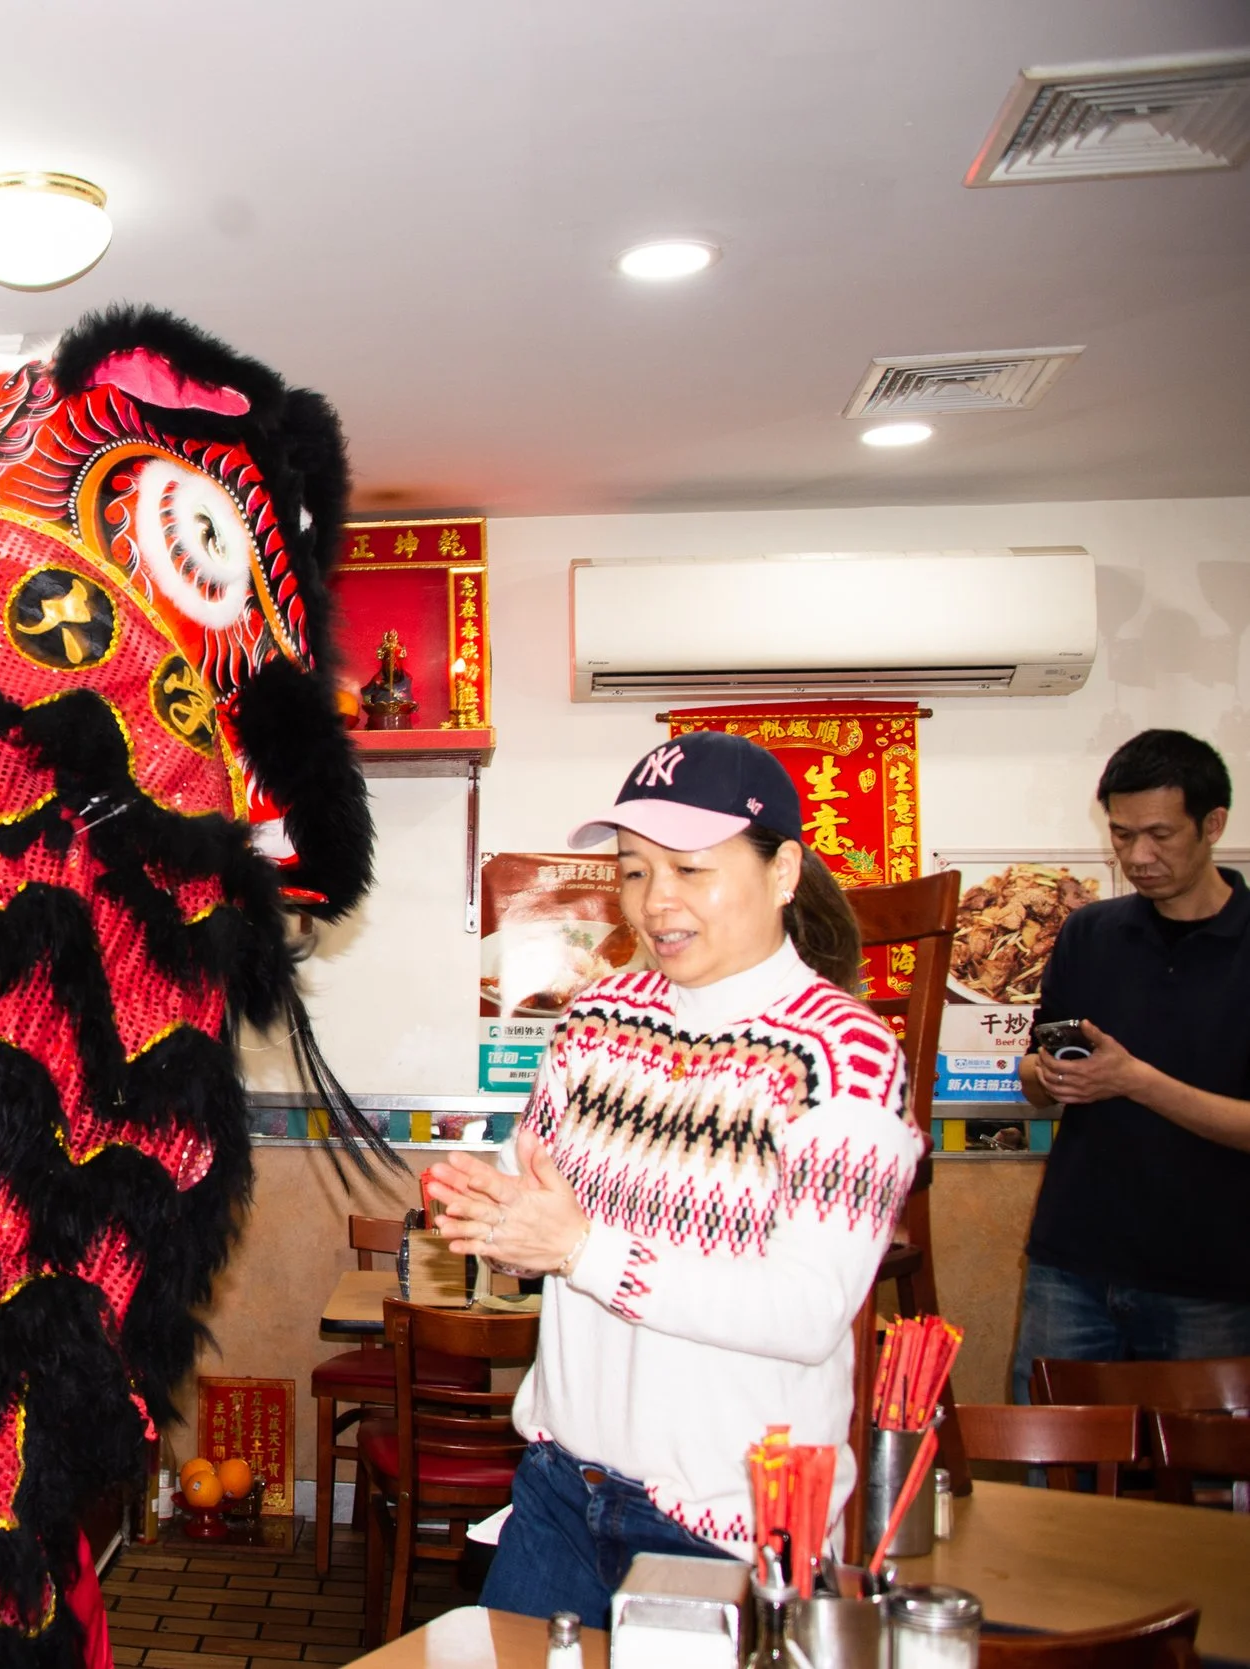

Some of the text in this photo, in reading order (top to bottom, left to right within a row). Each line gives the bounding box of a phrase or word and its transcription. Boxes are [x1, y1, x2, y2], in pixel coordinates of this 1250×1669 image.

[635, 745, 685, 786] NY
[887, 761, 918, 976] 生意興隆海
[980, 1012, 1029, 1034] 干炒
[995, 1038, 1031, 1046] Beef Ch
[250, 1390, 266, 1472] 五方五土龍
